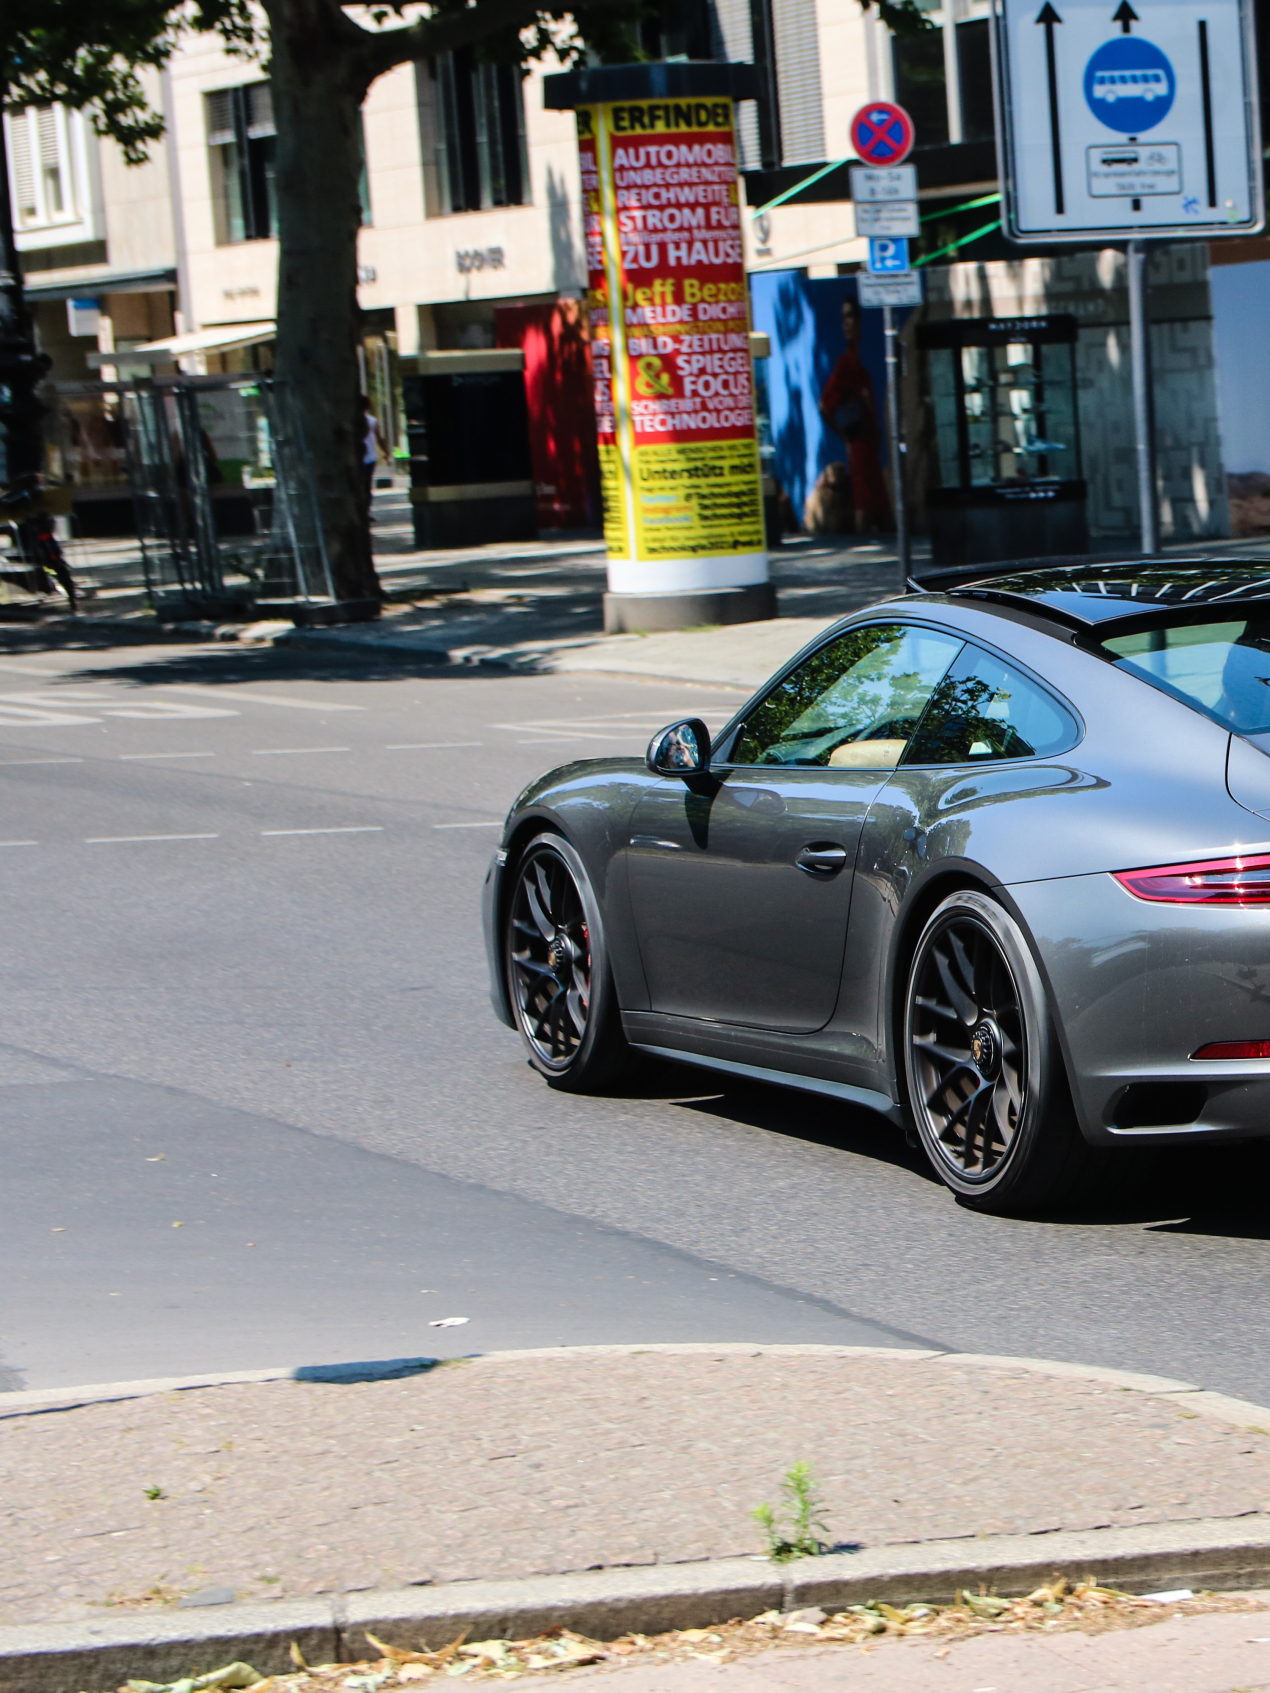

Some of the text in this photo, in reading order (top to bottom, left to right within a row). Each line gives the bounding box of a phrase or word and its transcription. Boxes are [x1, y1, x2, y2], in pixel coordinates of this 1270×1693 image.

[619, 208, 706, 232] STROM
[622, 243, 660, 270] ZU
[667, 240, 744, 267] HAUSE
[625, 278, 746, 307] Jeff Bezos
[625, 303, 693, 325] MELDE
[676, 352, 752, 376] SPIEGEL
[684, 373, 751, 398] FOCUS
